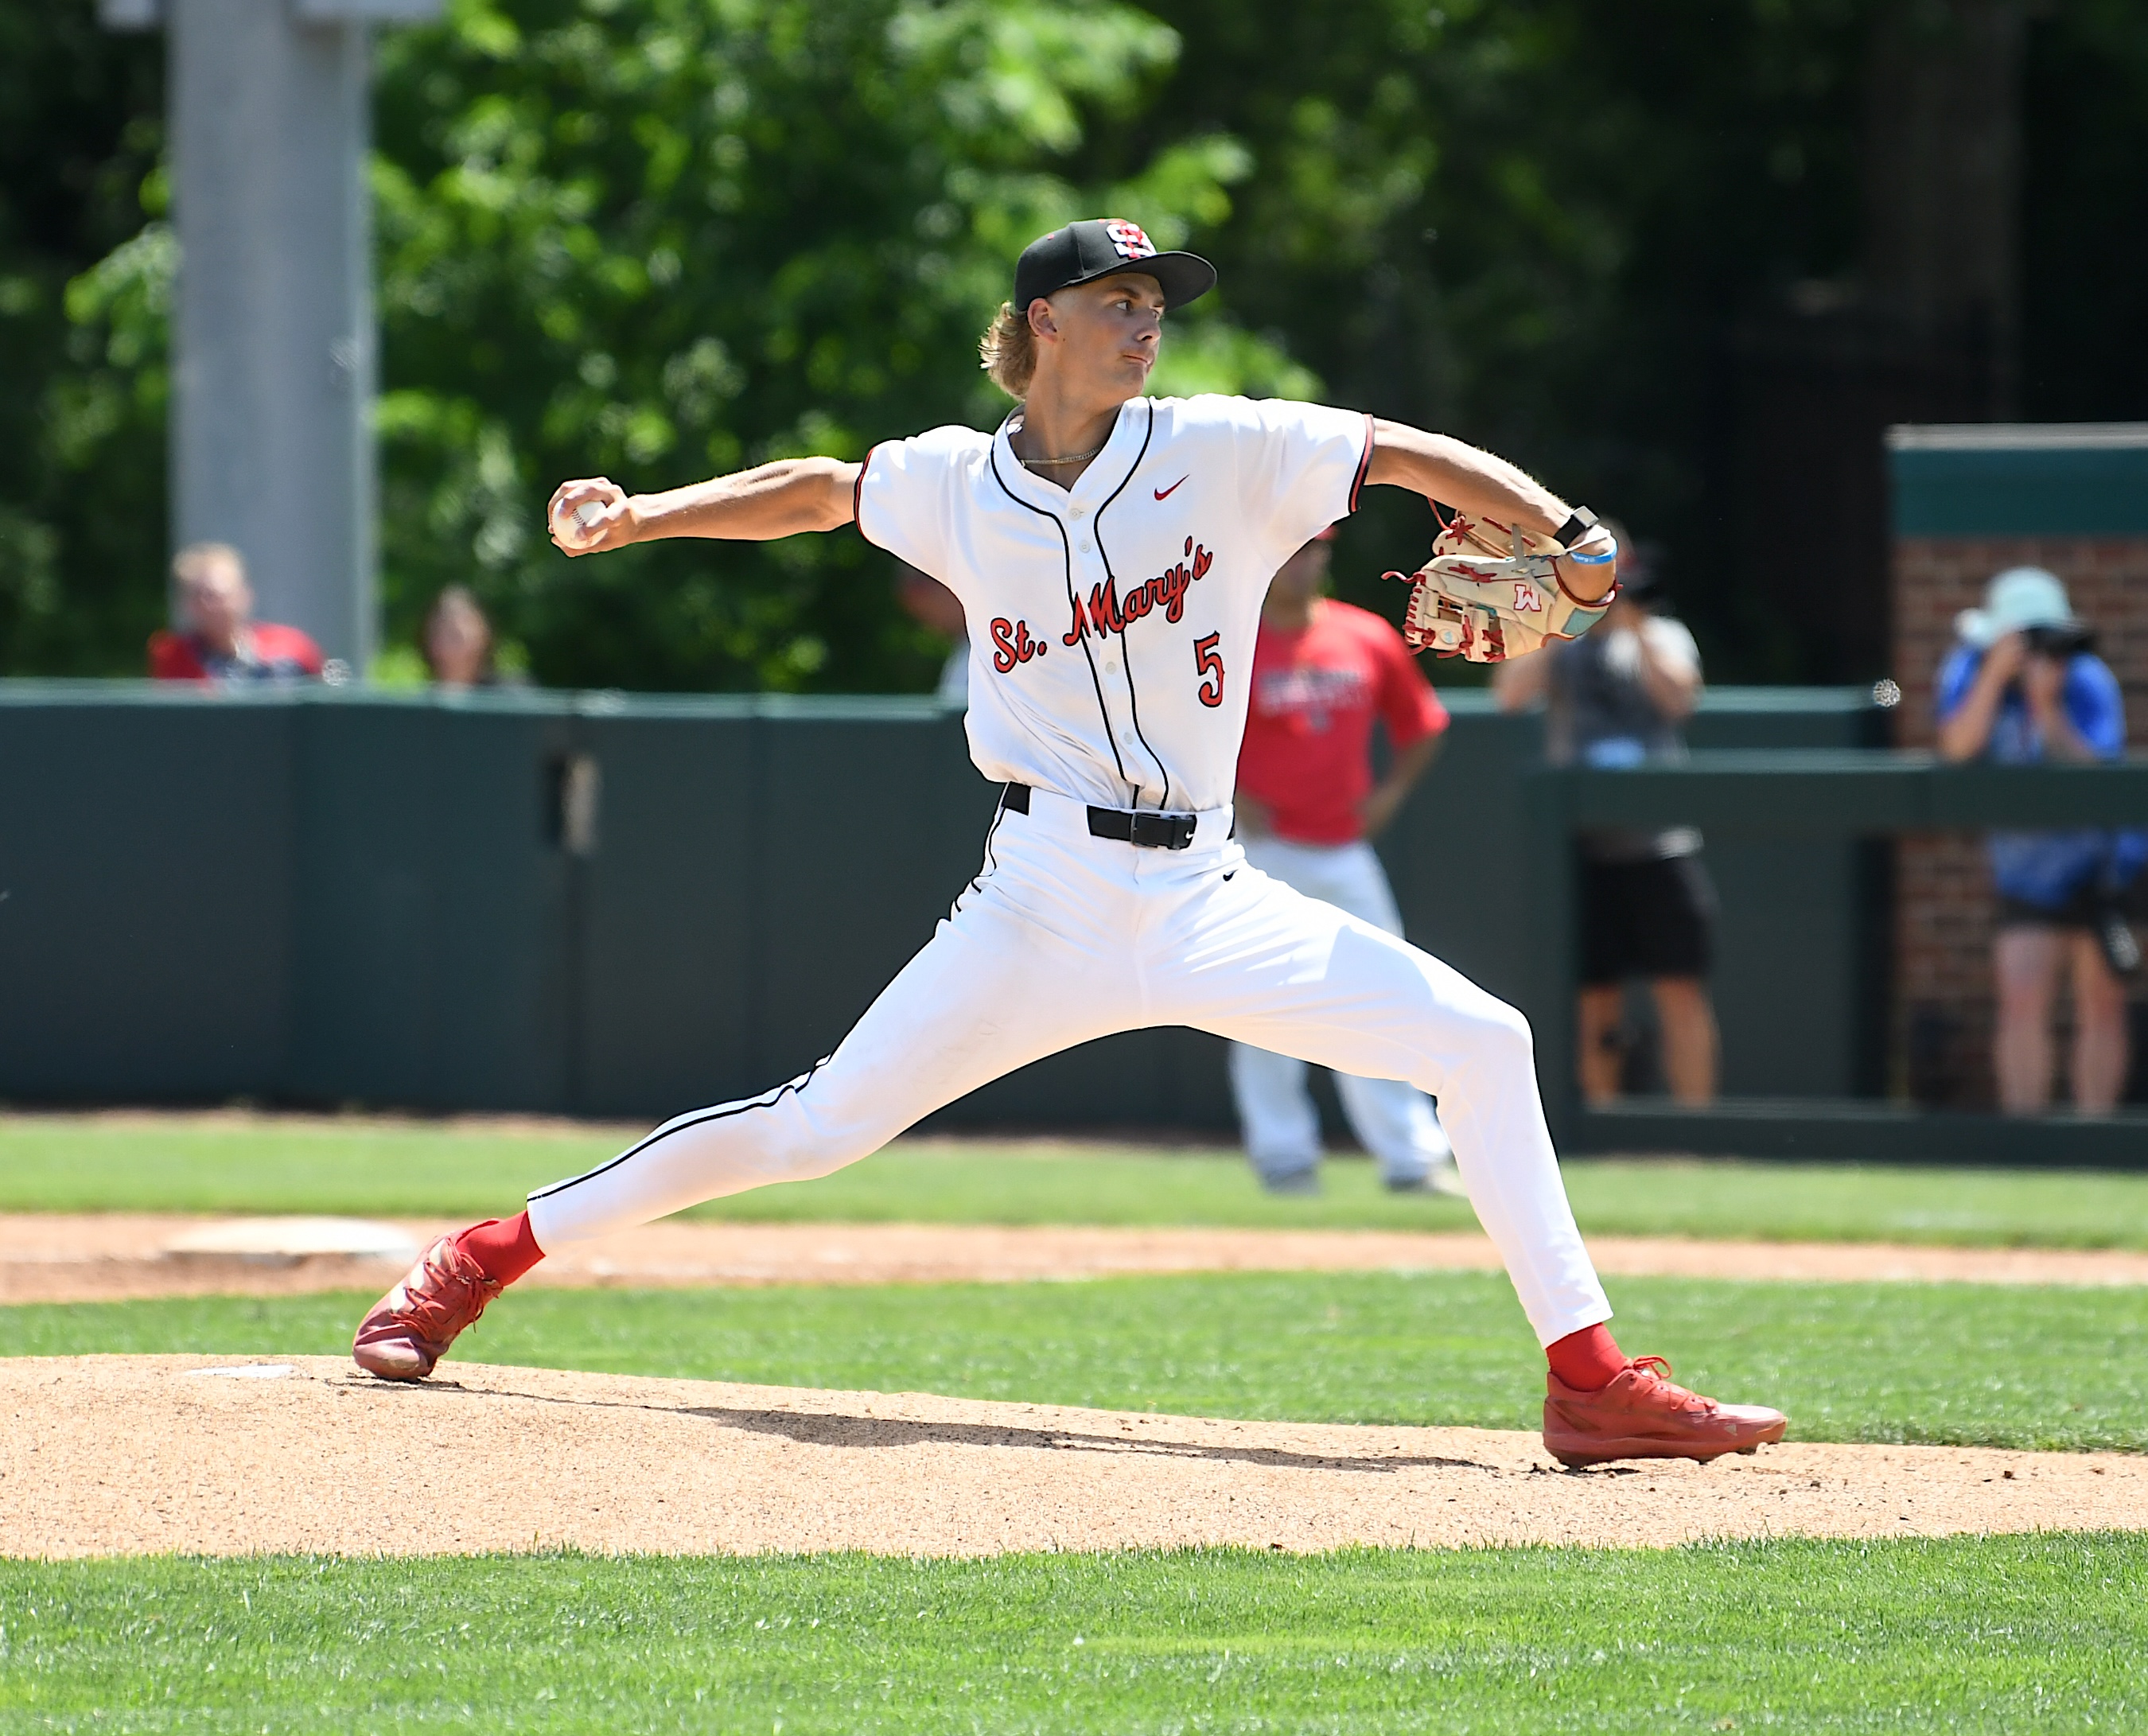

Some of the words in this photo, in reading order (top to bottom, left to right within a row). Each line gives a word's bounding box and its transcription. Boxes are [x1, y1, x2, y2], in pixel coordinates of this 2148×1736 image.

[990, 617, 1047, 673] St.
[1063, 535, 1212, 647] Mary's
[1193, 630, 1225, 707] 5
